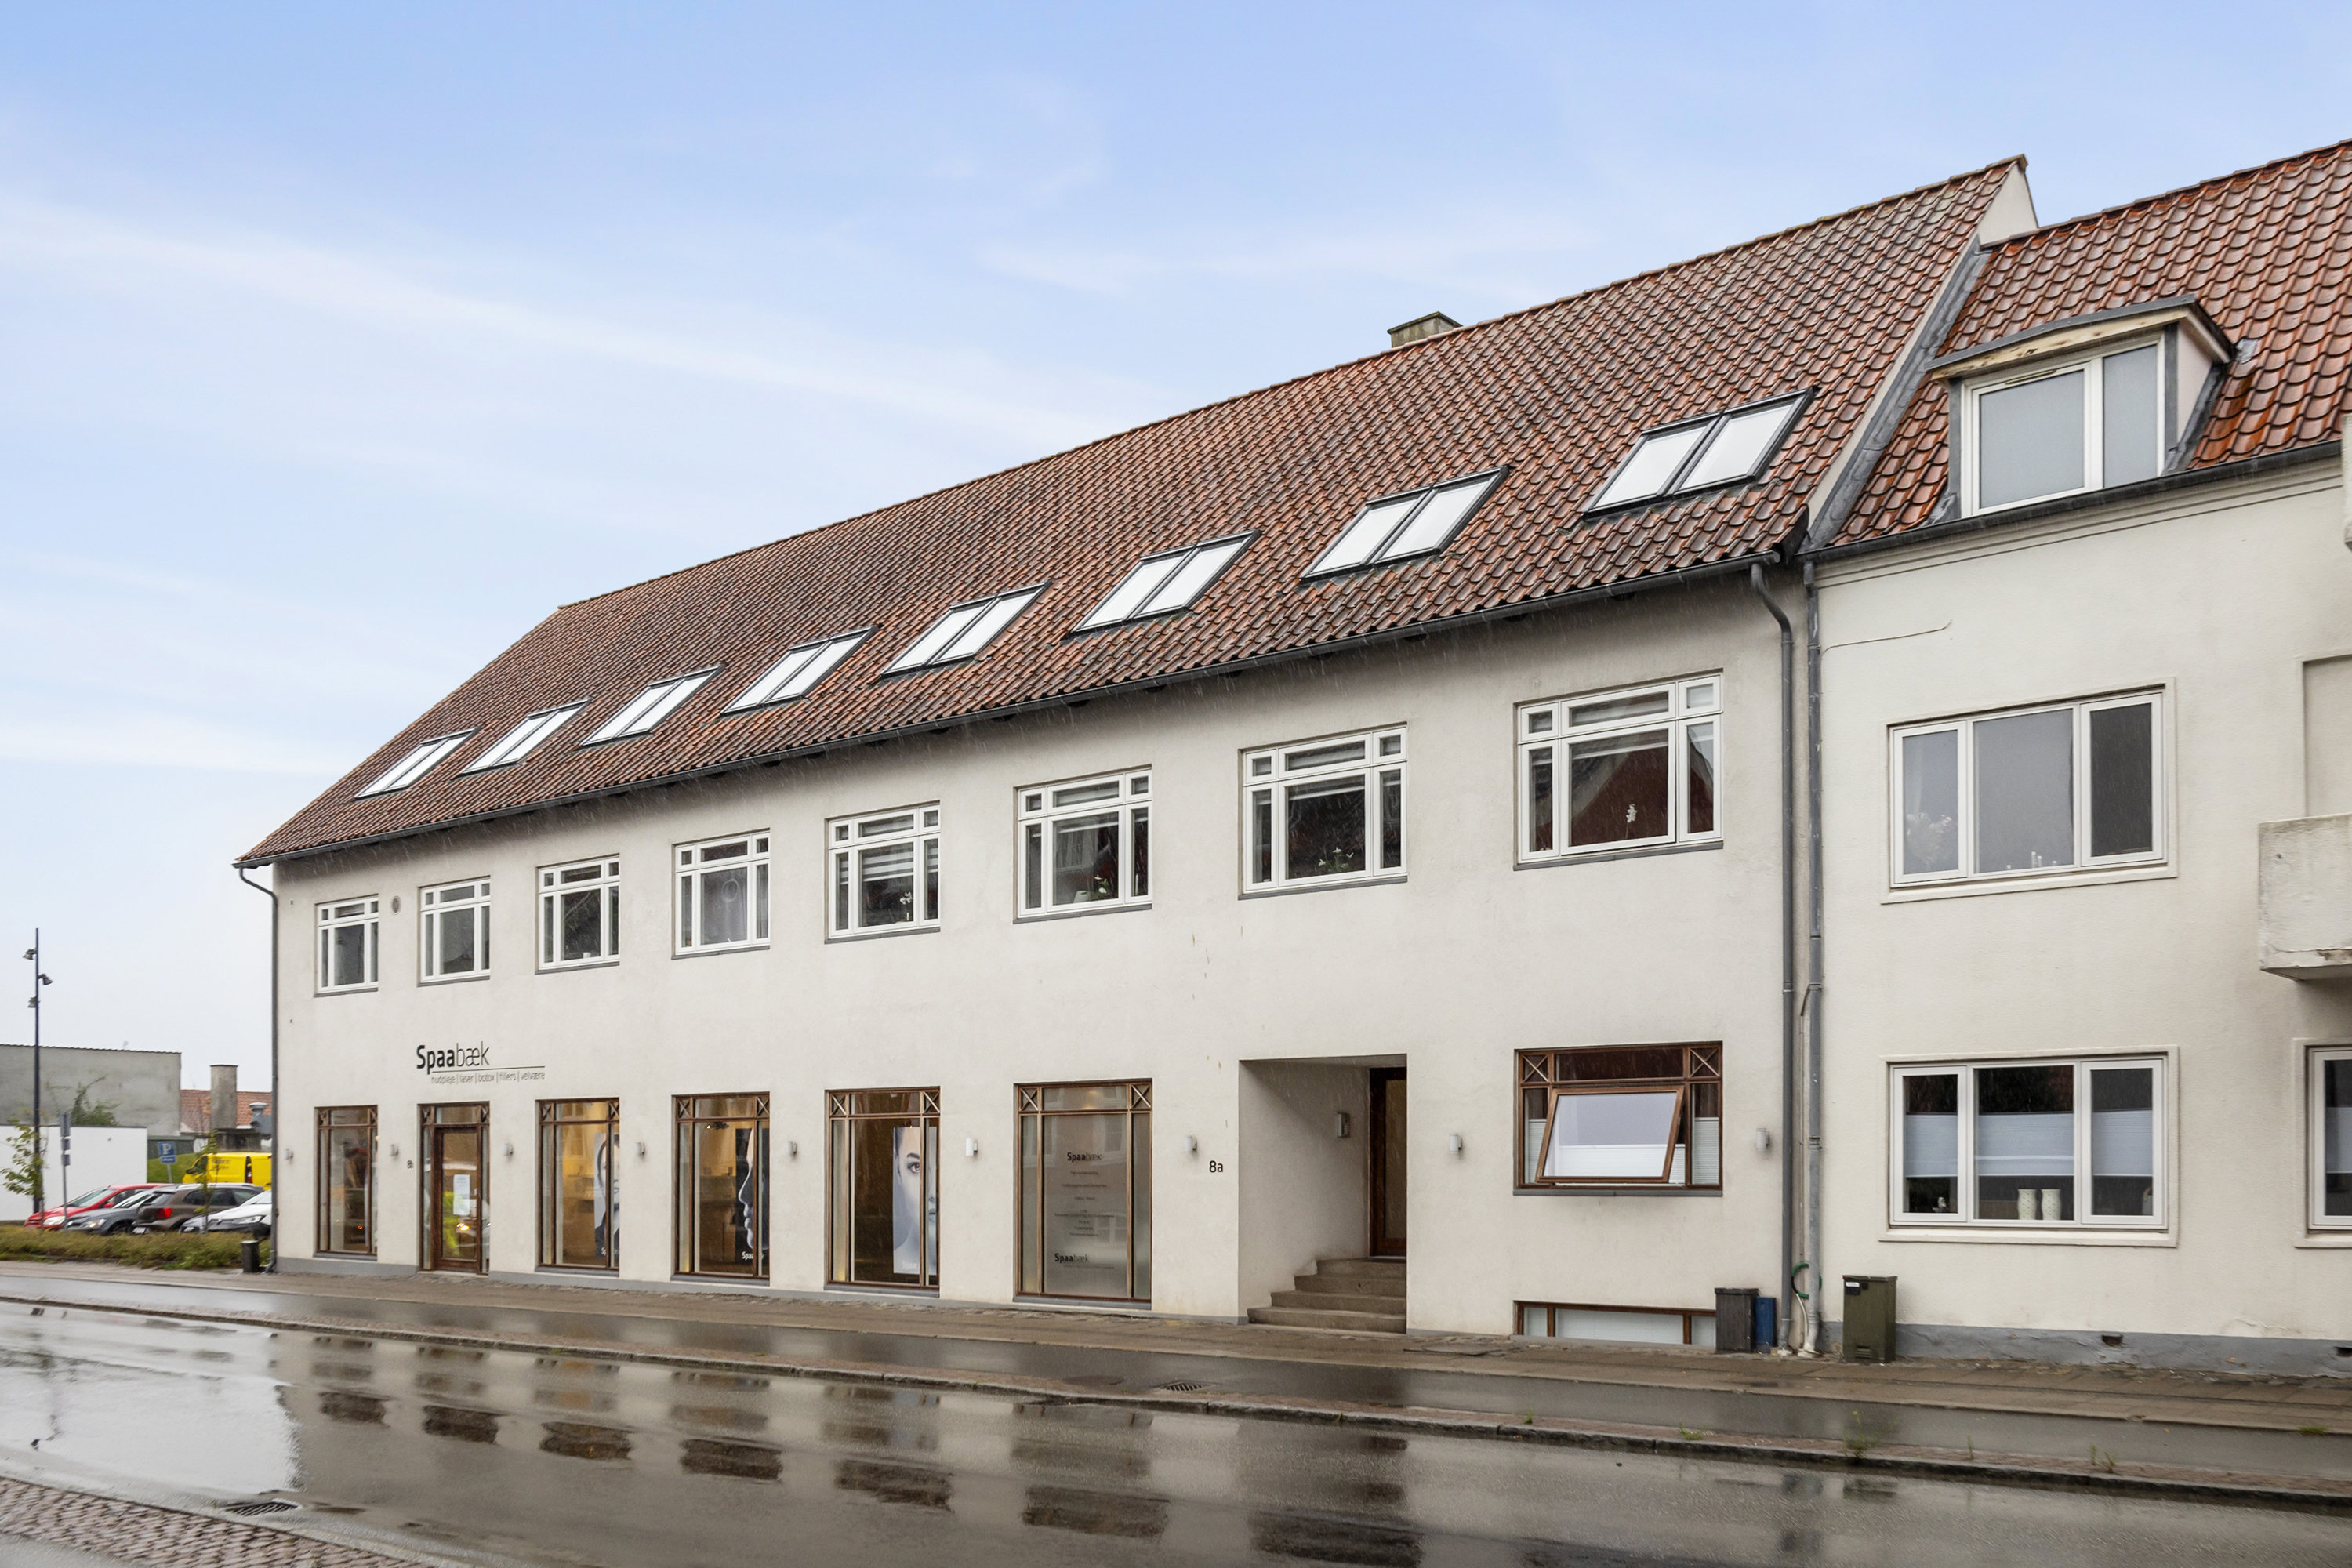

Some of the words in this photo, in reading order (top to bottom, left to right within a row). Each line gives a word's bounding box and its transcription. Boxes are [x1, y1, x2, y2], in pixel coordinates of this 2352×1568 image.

[416, 1040, 490, 1075] Spaabæk
[477, 1072, 495, 1083] botox
[521, 1070, 546, 1080] velvære
[162, 1143, 172, 1155] P
[1067, 1152, 1102, 1163] Spaabæk
[1209, 1160, 1224, 1173] 8a
[1054, 1253, 1090, 1264] Spaabæk
